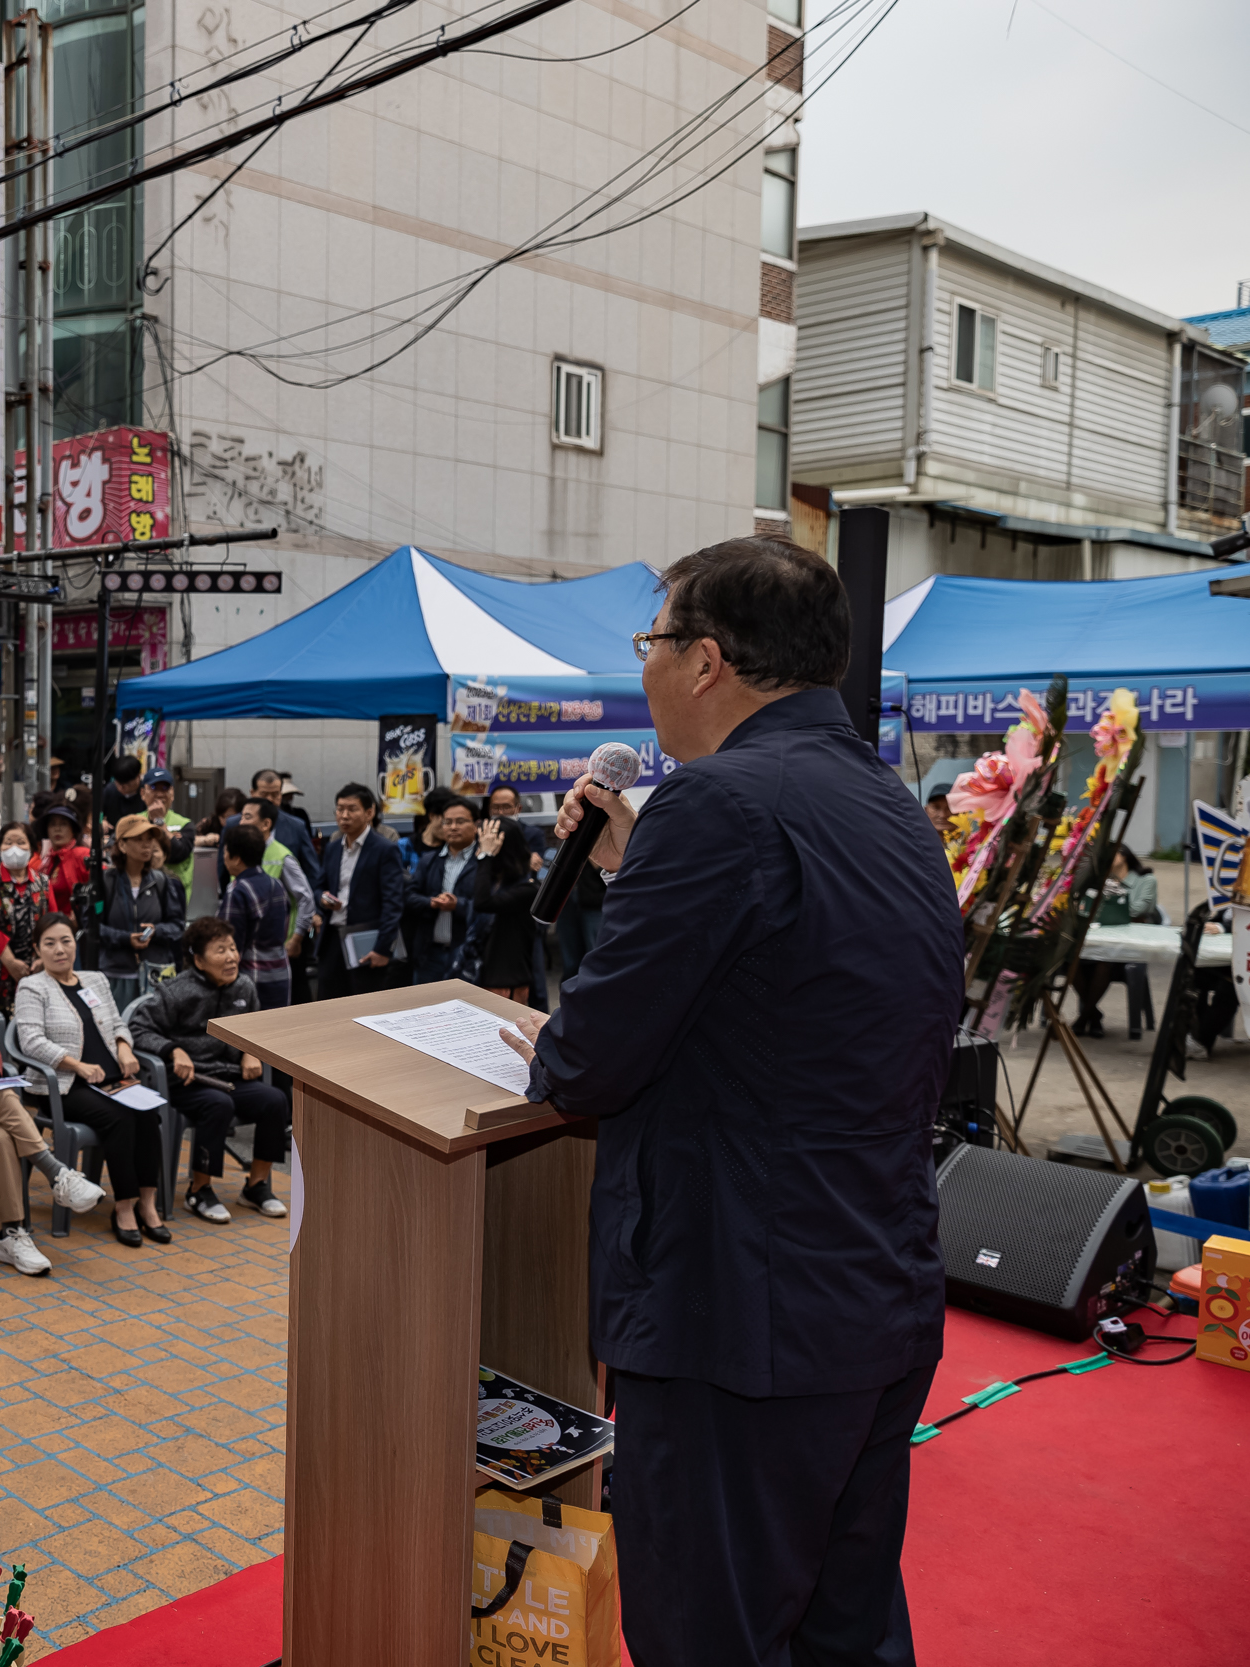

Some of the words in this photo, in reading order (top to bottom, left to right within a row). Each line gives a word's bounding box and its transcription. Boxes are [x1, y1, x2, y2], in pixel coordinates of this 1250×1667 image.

[131, 435, 155, 542] 노래방
[465, 701, 494, 723] 제1회
[491, 1624, 570, 1666] LOVE
